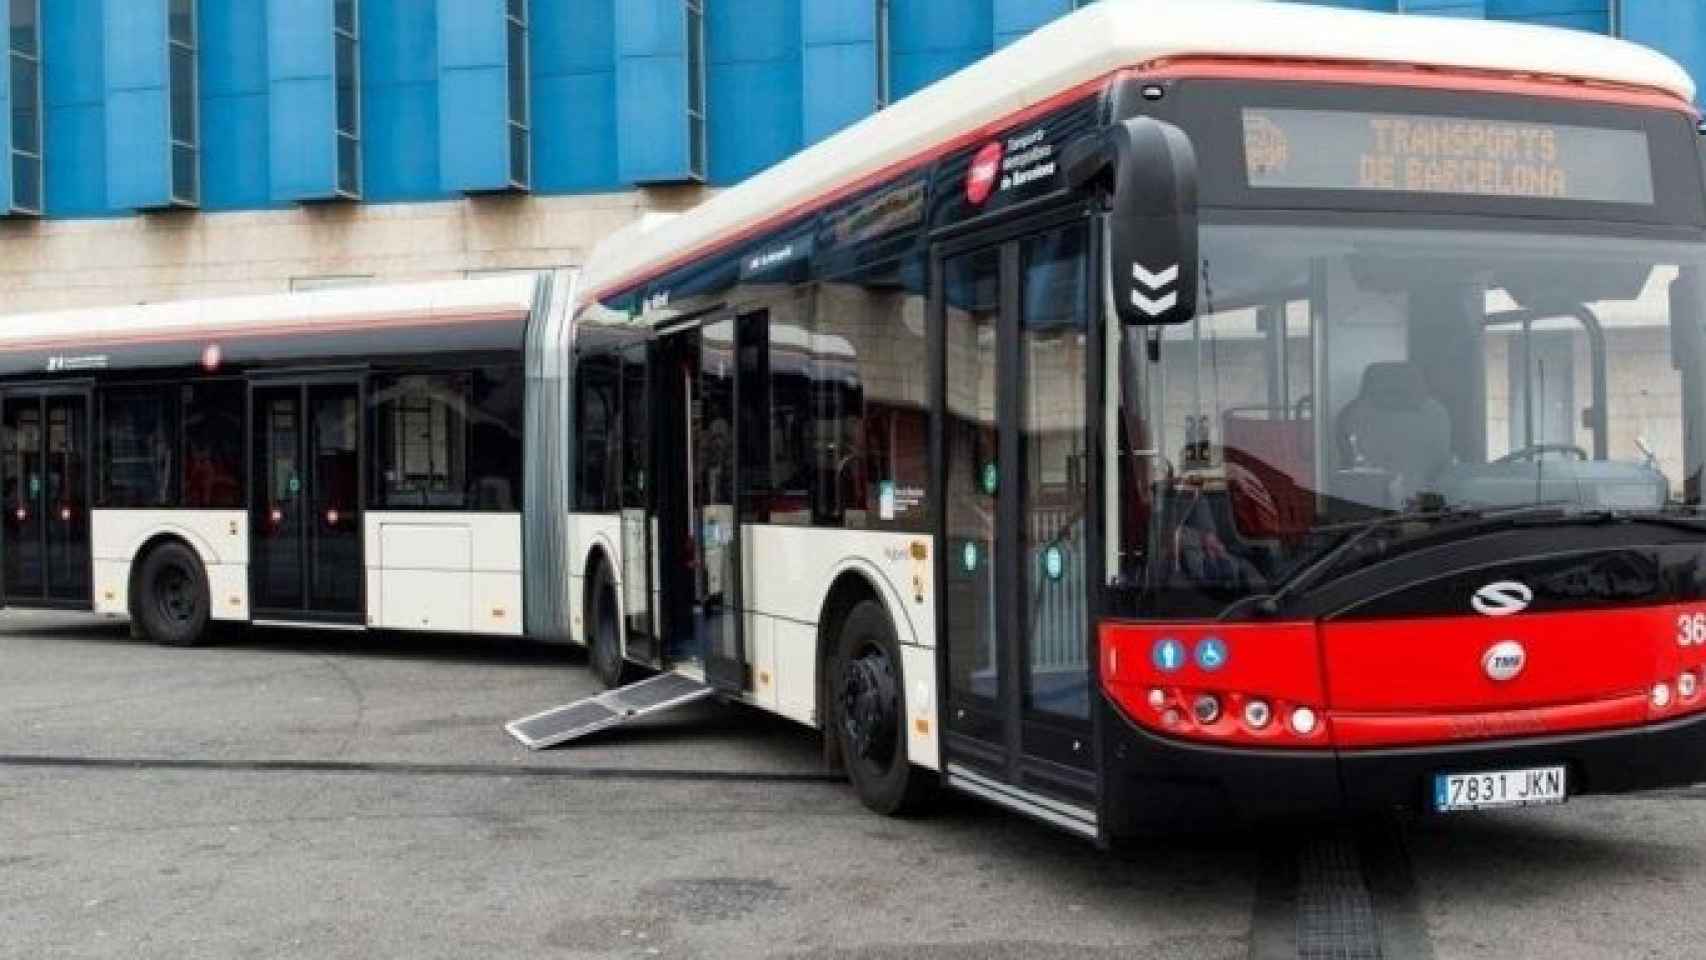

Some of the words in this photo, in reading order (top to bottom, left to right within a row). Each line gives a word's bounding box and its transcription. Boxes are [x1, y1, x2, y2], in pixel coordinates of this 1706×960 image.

[1370, 119, 1555, 160] TRANSPORTS
[1359, 158, 1394, 187] DE
[1407, 159, 1567, 196] BARCELONA
[1450, 774, 1507, 801] 7831
[1518, 769, 1560, 797] JKN
